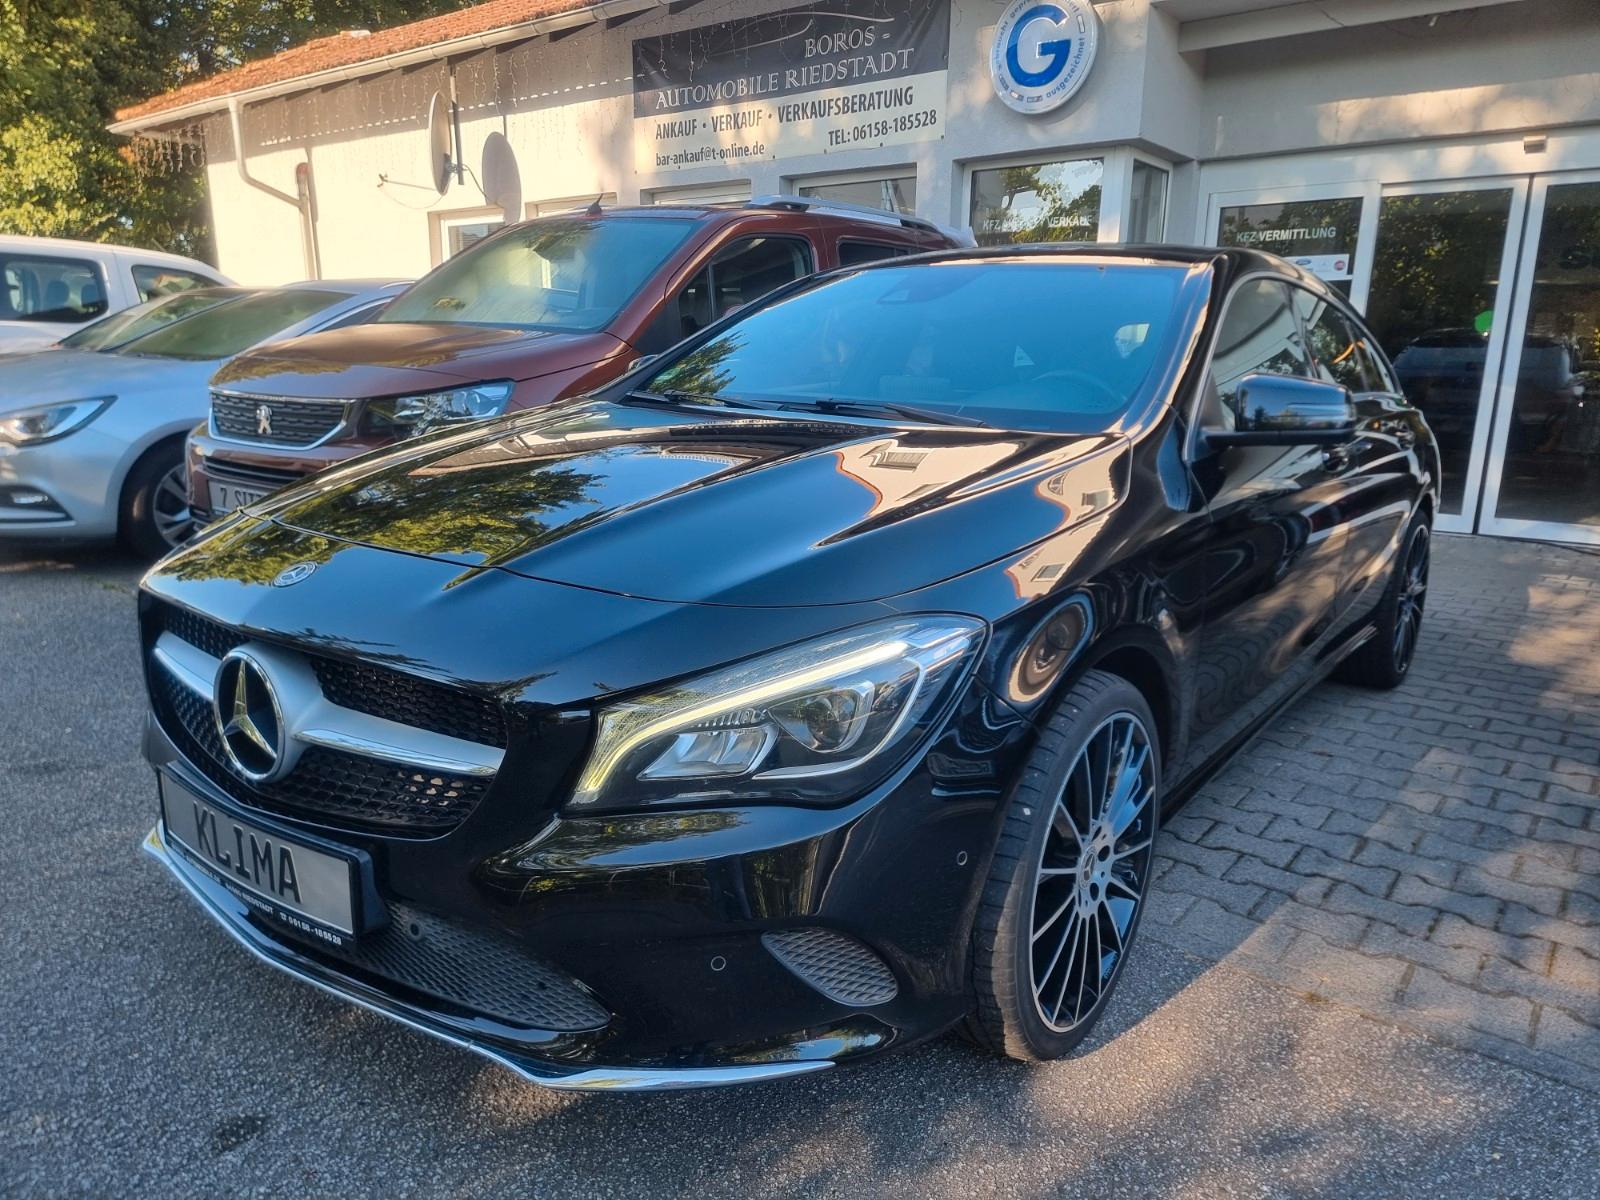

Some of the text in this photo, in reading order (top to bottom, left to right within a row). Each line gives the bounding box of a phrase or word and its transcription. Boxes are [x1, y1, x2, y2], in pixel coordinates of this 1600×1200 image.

[804, 25, 876, 58] BOROS
[1006, 4, 1071, 87] G
[656, 48, 915, 109] AUTOMOBILE RIEDSTADT
[1046, 37, 1085, 98] ausgezeichnet
[656, 86, 914, 140] ANKAUF VERKAUF VERKAUFSBERATUNG
[828, 109, 937, 147] TEL: 06158-185528
[656, 141, 765, 167] bar-ankauf@t-online.de
[1259, 226, 1337, 242] VERMITTLUNG
[234, 490, 262, 508] SIT
[193, 800, 303, 905] KLIMA
